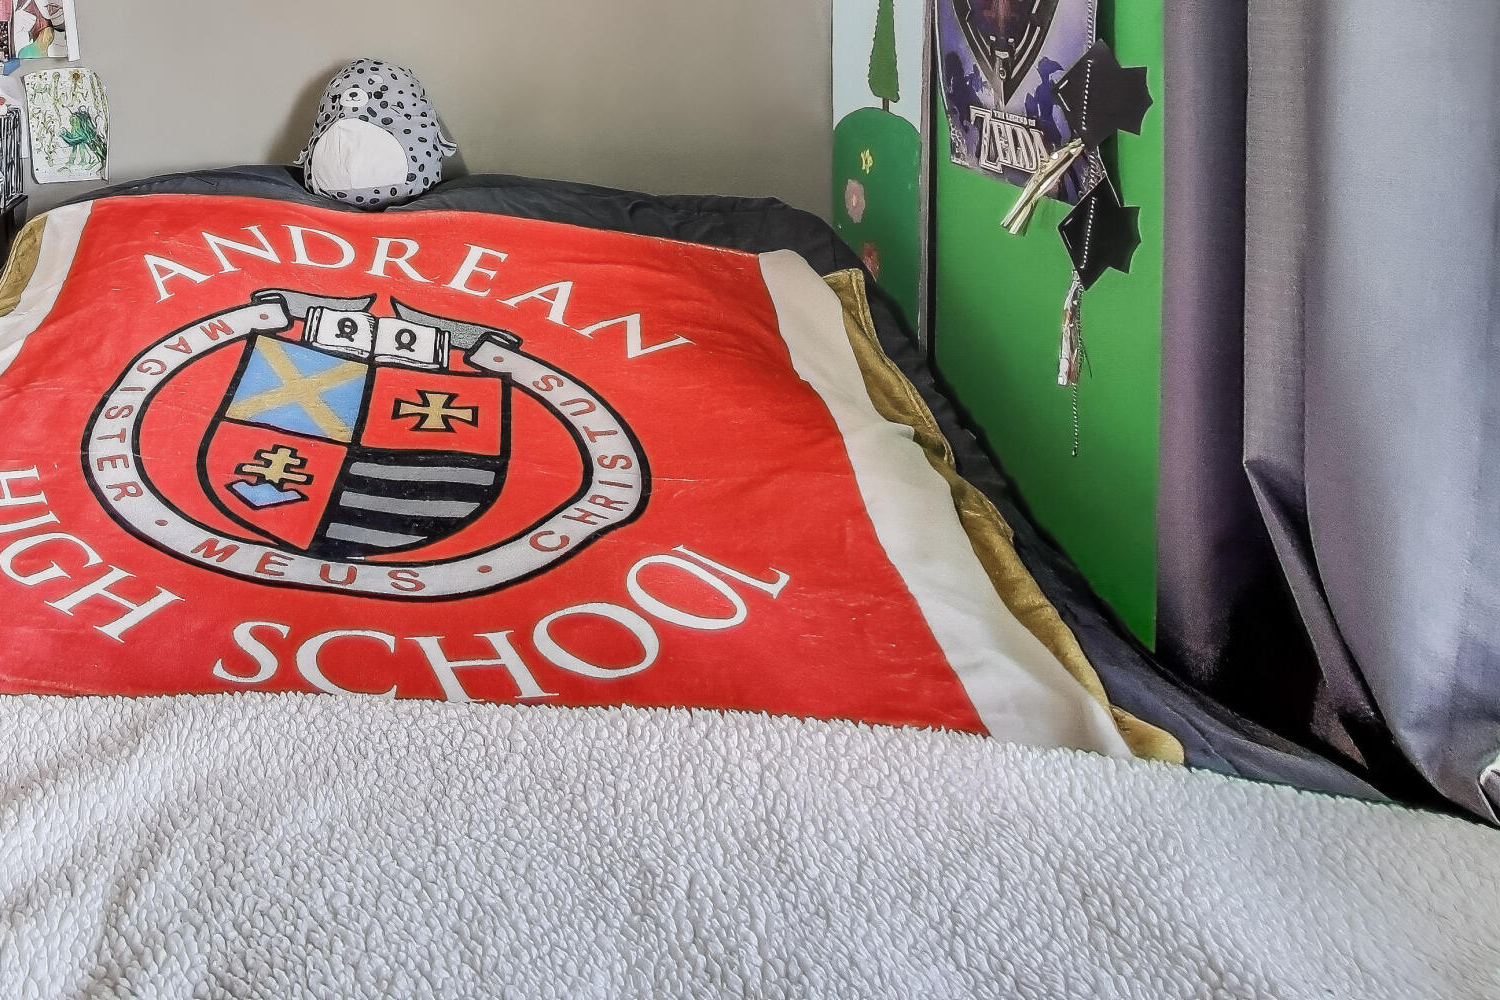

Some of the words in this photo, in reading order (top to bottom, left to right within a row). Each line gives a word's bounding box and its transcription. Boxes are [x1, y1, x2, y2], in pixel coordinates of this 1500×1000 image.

[969, 105, 1050, 174] ZELDA
[143, 223, 697, 360] ANDREAN
[95, 318, 235, 502] MAGISTER
[191, 537, 426, 592] MEUS
[528, 373, 633, 554] CHRISTUS
[212, 544, 790, 702] SCHOOL
